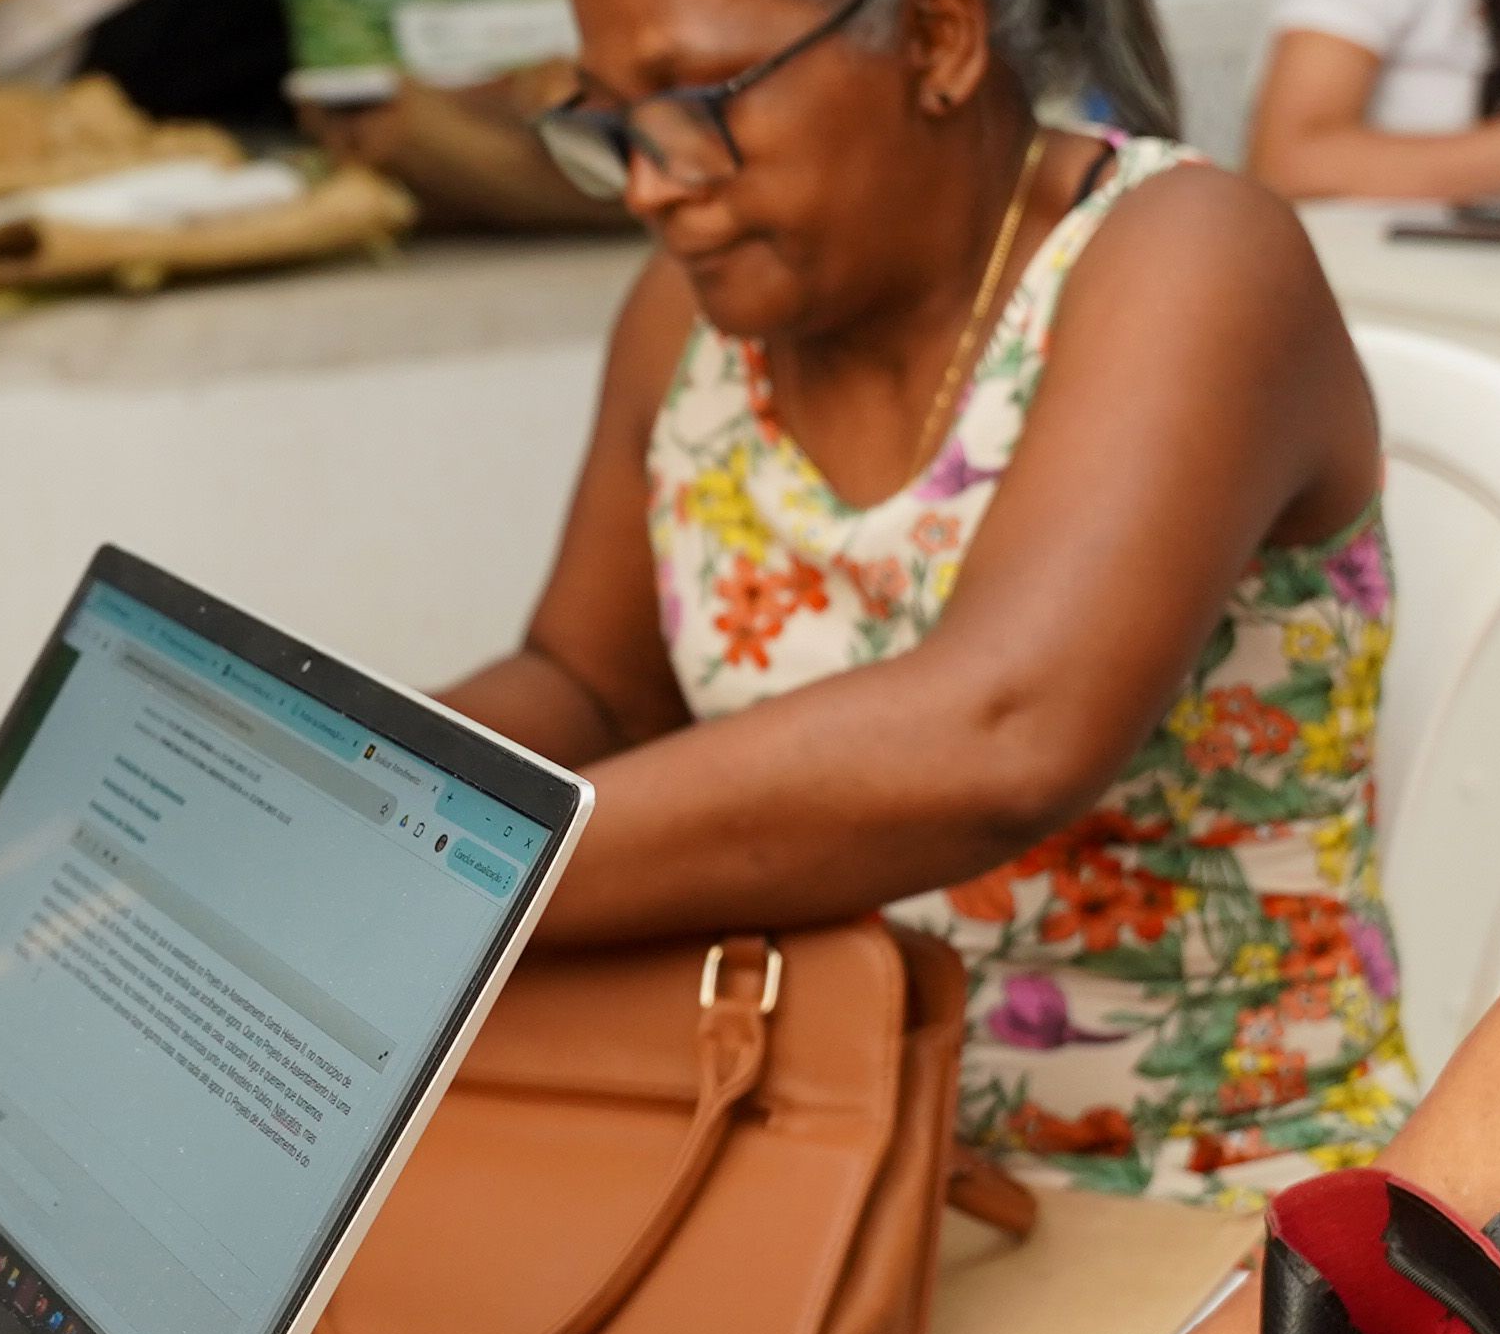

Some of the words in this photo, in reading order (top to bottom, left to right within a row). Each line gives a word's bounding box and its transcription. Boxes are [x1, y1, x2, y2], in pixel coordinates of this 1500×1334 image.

[263, 1015, 283, 1035] Santa
[279, 1027, 302, 1051] Helena
[305, 1049, 316, 1062] no
[312, 1053, 344, 1085] município
[341, 1074, 352, 1088] de
[241, 1024, 256, 1041] Que
[253, 1035, 263, 1047] no
[259, 1039, 283, 1064] Projeto
[280, 1055, 291, 1068] de
[287, 1060, 330, 1098] Assentamento
[327, 1090, 338, 1104] há
[335, 1098, 351, 1116] uma
[224, 1090, 233, 1103] O
[261, 1070, 286, 1095] querem
[281, 1086, 297, 1104] que
[225, 1064, 254, 1093] Ministério
[301, 1128, 317, 1145] mas
[228, 1095, 252, 1122] Projeto
[248, 1111, 259, 1125] de
[256, 1117, 297, 1156] Assentamento
[294, 1149, 302, 1160] é
[299, 1153, 311, 1167] do
